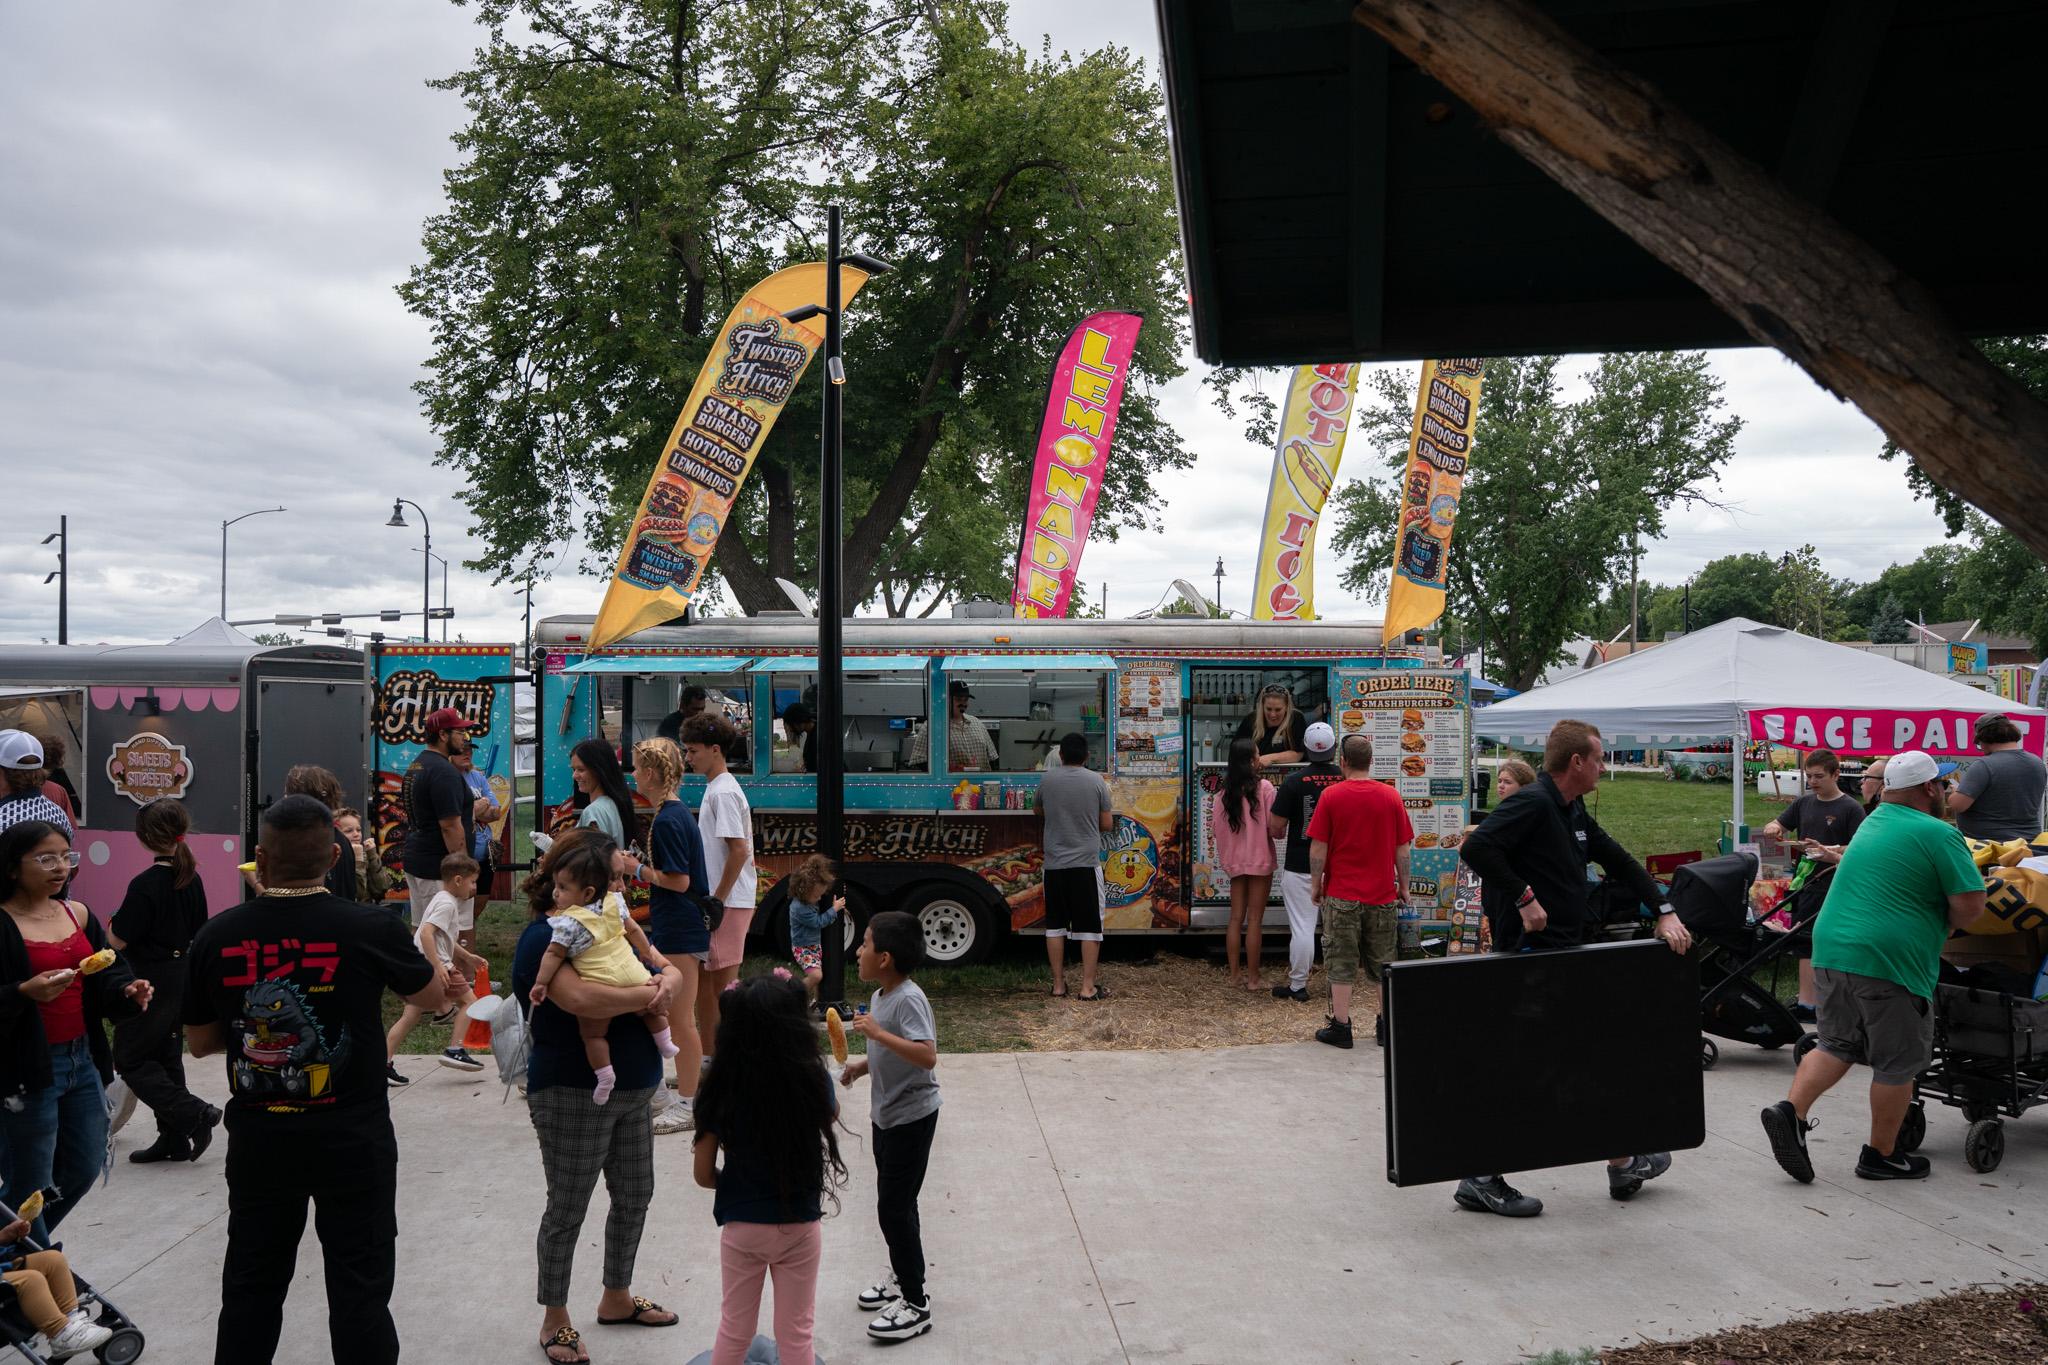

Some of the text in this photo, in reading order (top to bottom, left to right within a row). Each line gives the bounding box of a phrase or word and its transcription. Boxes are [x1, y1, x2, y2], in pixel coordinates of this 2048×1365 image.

[730, 324, 801, 370] TWISTED
[724, 362, 787, 397] HITCH
[1429, 395, 1465, 426] BURGERS
[1432, 380, 1467, 413] SMASH
[696, 412, 751, 449] BURGERS
[703, 398, 759, 437] SMASH
[1423, 416, 1465, 449] HOTDOGS
[683, 430, 742, 472] HOTDOGS
[1417, 440, 1464, 472] LEMNADES
[670, 452, 733, 495] LEMONADES
[1027, 327, 1118, 610] LEMONADE
[640, 549, 684, 571] TWISTED
[651, 546, 673, 561] LITTLE
[1268, 510, 1316, 620] DOG
[641, 562, 673, 577] DEFINITE
[1127, 661, 1175, 669] ORDER HERE
[1356, 676, 1455, 695] ORDER HERE
[384, 678, 485, 734] HITCH
[1362, 700, 1443, 708] SMASHBURGERS
[1424, 711, 1433, 719] $13
[131, 738, 166, 750] HAND DIPPED
[1762, 714, 2030, 750] FACE PAIT
[127, 751, 172, 768] SWEETS
[126, 771, 173, 788] STREETS
[1205, 776, 1218, 790] $7
[134, 791, 145, 800] ICE
[763, 817, 978, 855] WISD HITCH
[1409, 882, 1435, 895] ADE
[221, 939, 341, 987] ゴジラ
[308, 985, 335, 993] RAMEN
